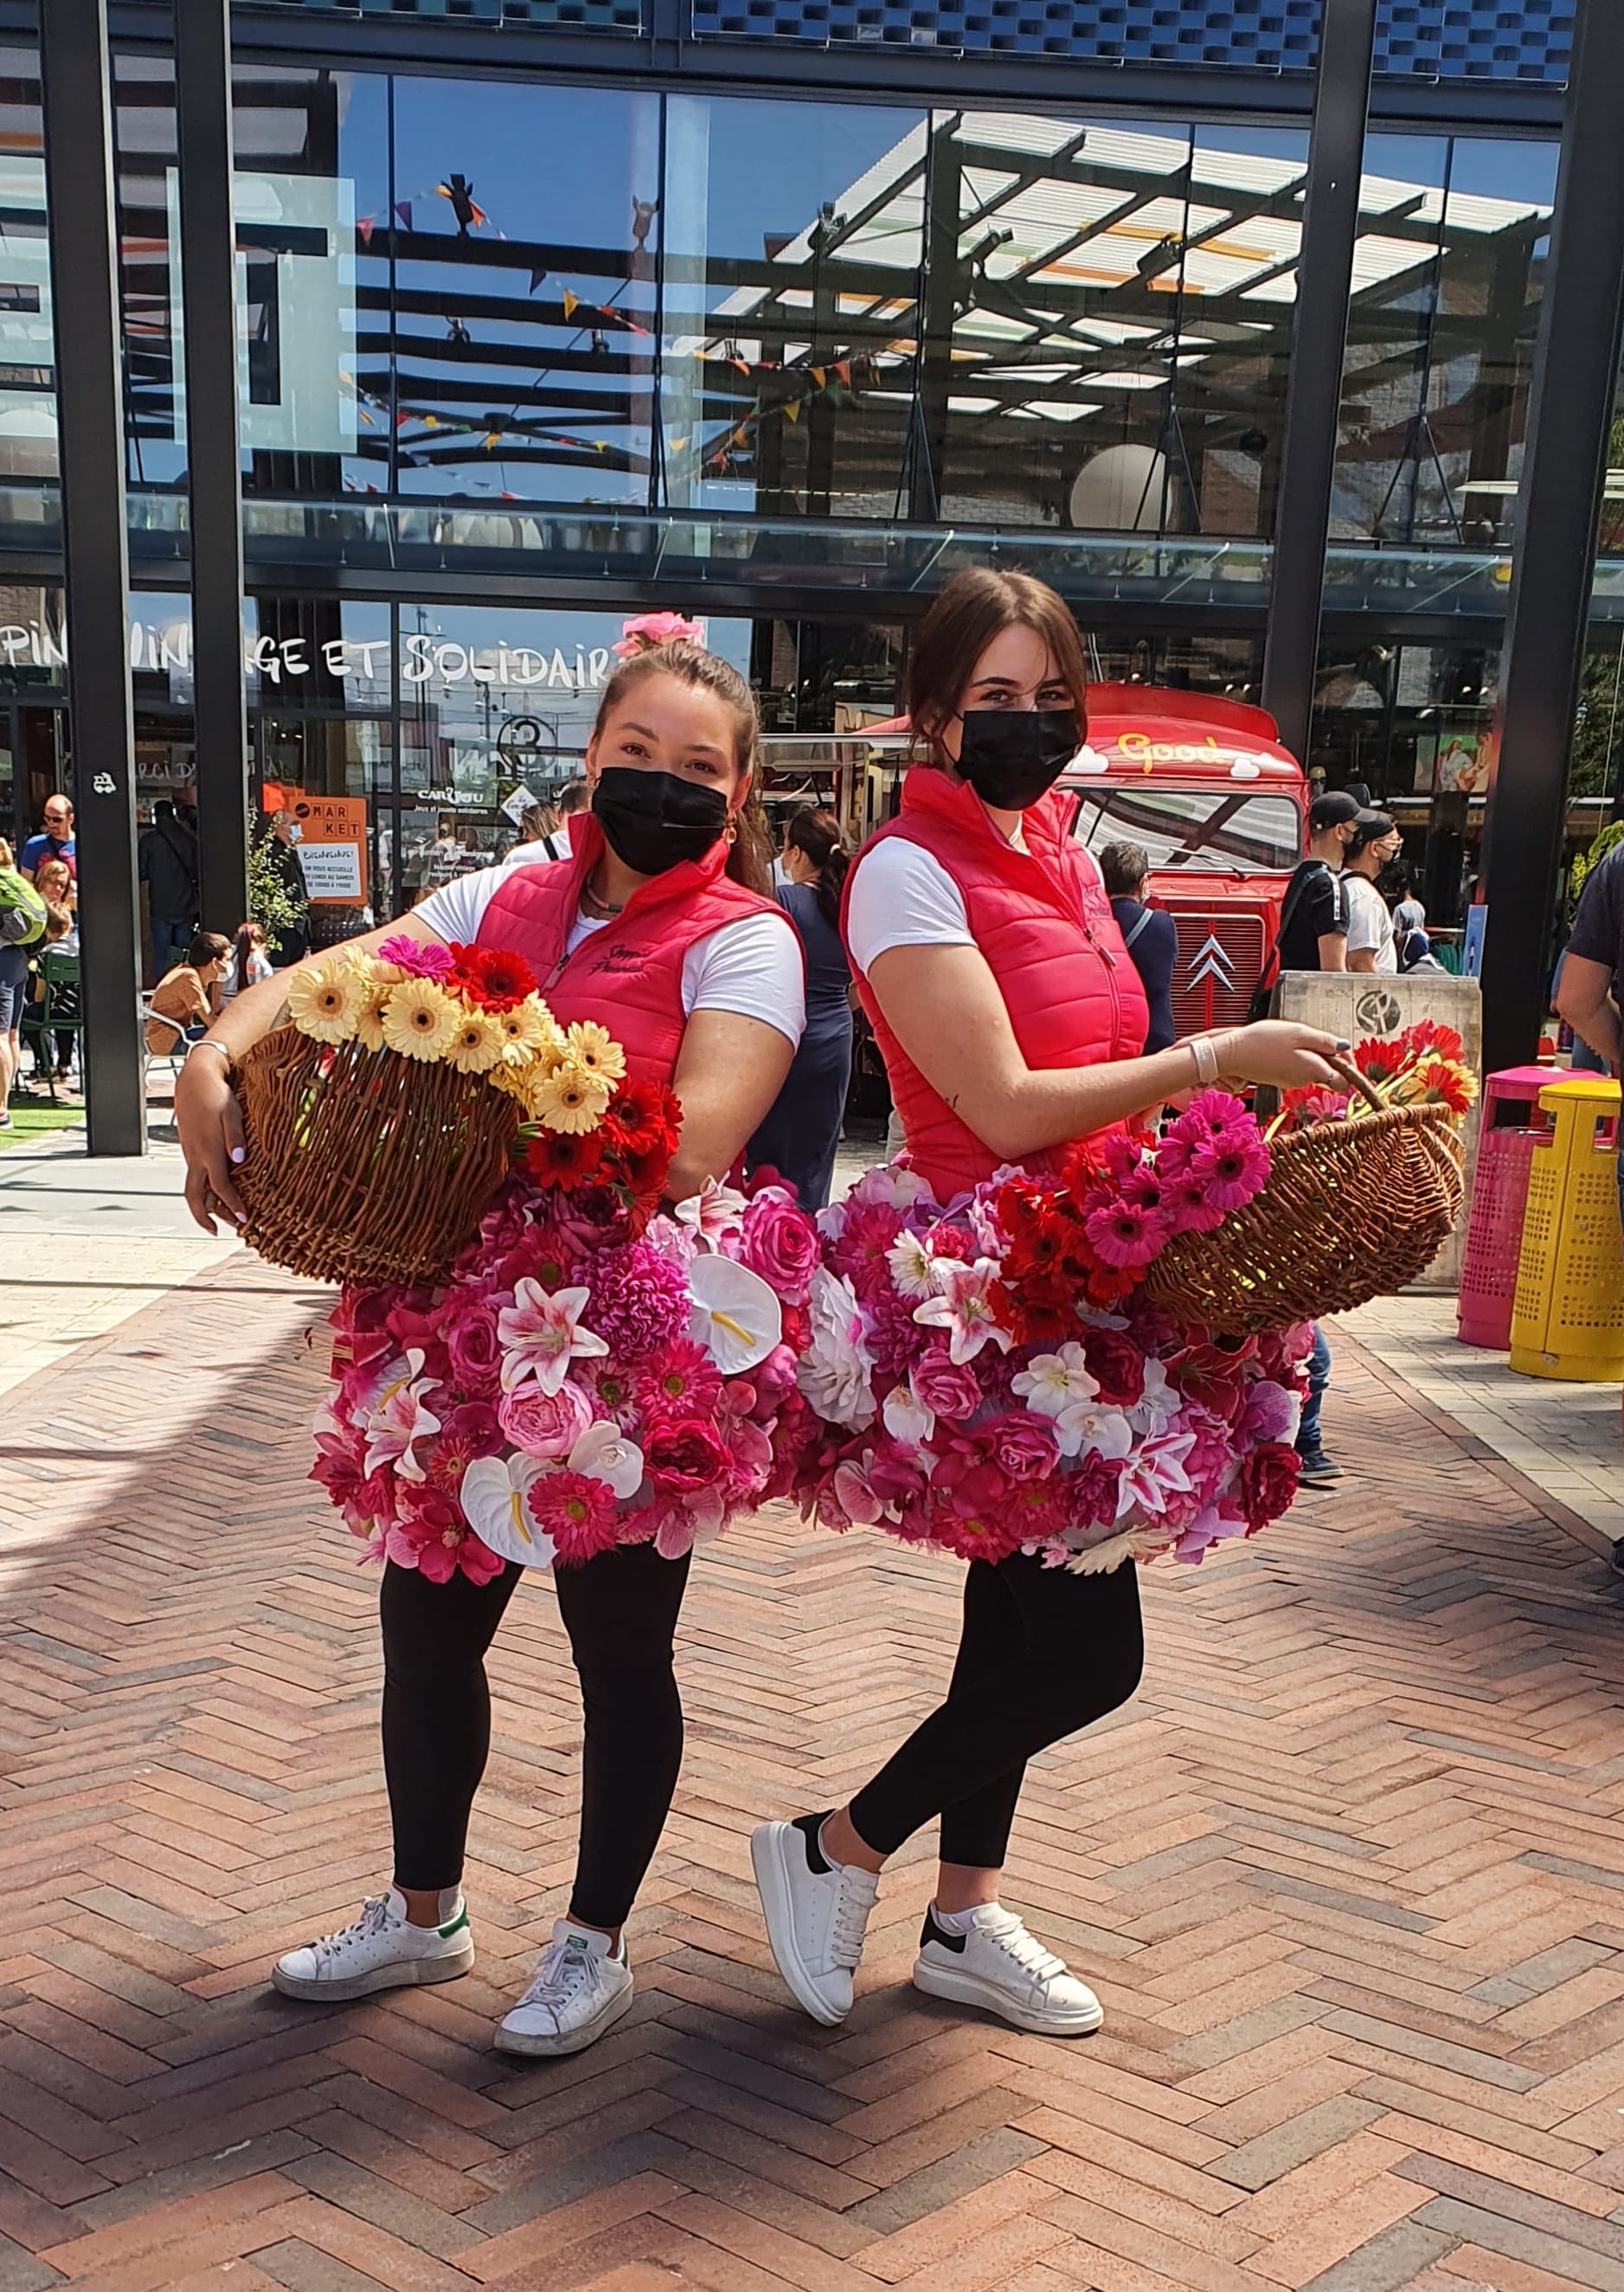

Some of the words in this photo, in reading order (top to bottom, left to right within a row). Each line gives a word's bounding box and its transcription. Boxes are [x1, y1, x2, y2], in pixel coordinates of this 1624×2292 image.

[321, 640, 390, 679] ET
[402, 634, 611, 689] SOLIDAIR
[1118, 733, 1226, 774] Good
[325, 824, 360, 836] KET
